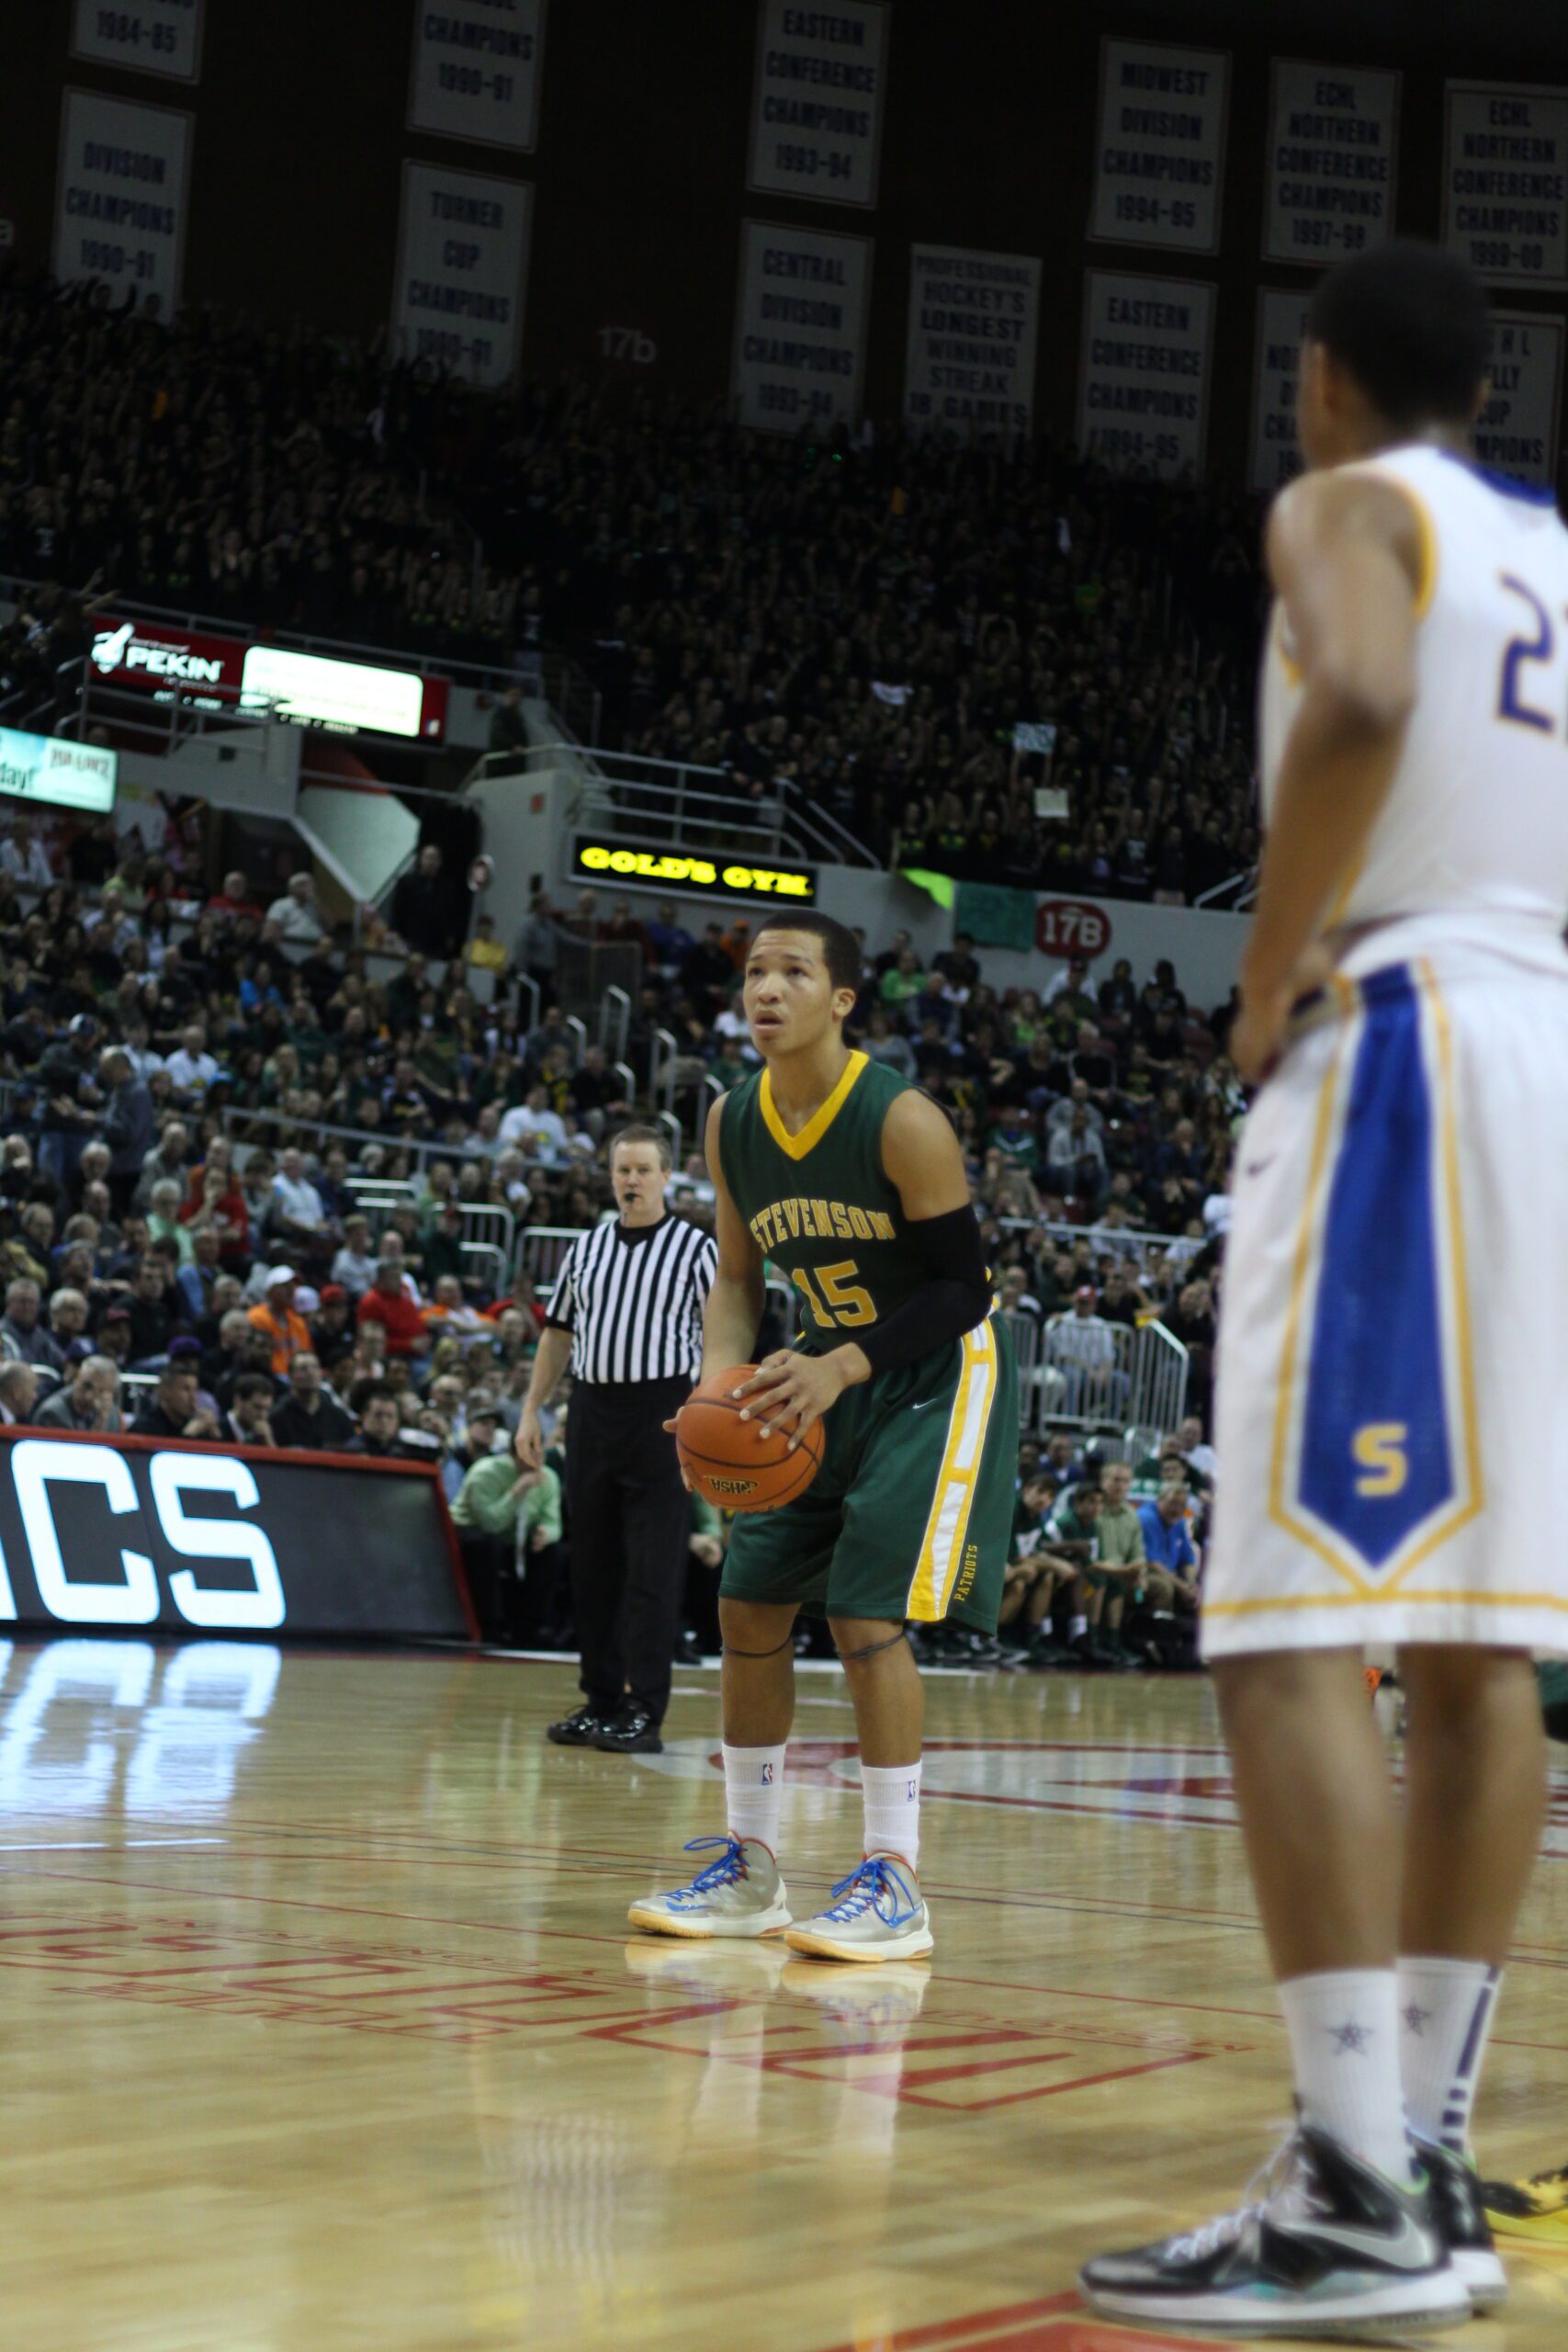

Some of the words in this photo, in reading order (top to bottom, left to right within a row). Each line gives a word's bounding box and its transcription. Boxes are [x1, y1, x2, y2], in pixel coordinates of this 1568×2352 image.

[423, 15, 533, 61] CHAMPIONS
[784, 9, 864, 46] EASTERN
[766, 51, 874, 93] CONFERENCE
[1121, 62, 1209, 96] MIDWEST
[1315, 81, 1357, 109] ECHL
[763, 96, 869, 137] CHAMPIONS
[1121, 107, 1202, 141] DIVISION
[1290, 113, 1380, 146] NORTHERN
[1490, 101, 1531, 127] ECHL
[776, 143, 852, 179] 1993-94
[1278, 146, 1387, 182] CONFERENCE
[1463, 133, 1556, 164] NORTHERN
[1103, 149, 1213, 186] CHAMPIONS
[1453, 169, 1565, 201] CONFERENCE
[66, 187, 175, 235] CHAMPIONS
[431, 190, 503, 230] TURNER
[1115, 194, 1196, 230] 1994-95
[1280, 183, 1382, 218] CHAMPIONS
[1456, 206, 1560, 237] CHAMPIONS
[444, 240, 480, 270] CUP
[762, 248, 846, 287] CENTRAL
[408, 279, 510, 323] CHAMPIONS
[761, 292, 842, 330] DIVISION
[924, 281, 1025, 313] HOCKEY'S
[1108, 298, 1190, 331] EASTERN
[921, 311, 1025, 341] LONGEST
[744, 335, 853, 377] CHAMPIONS
[926, 339, 1016, 368] WINNING
[1091, 338, 1201, 378] CONFERENCE
[929, 366, 1009, 395] STREAK
[1088, 383, 1198, 422] CHAMPIONS
[1478, 399, 1511, 425] UP
[1475, 435, 1544, 464] MPIONS
[126, 645, 221, 683] PEKIN
[581, 846, 717, 885] GOLD'S
[1043, 911, 1102, 948] 17B
[750, 1197, 897, 1253] STEVENSON
[792, 1260, 878, 1328] 15
[1352, 1421, 1409, 1498] S
[0, 1439, 287, 1629] CS
[953, 1544, 978, 1602] PATRIOTS
